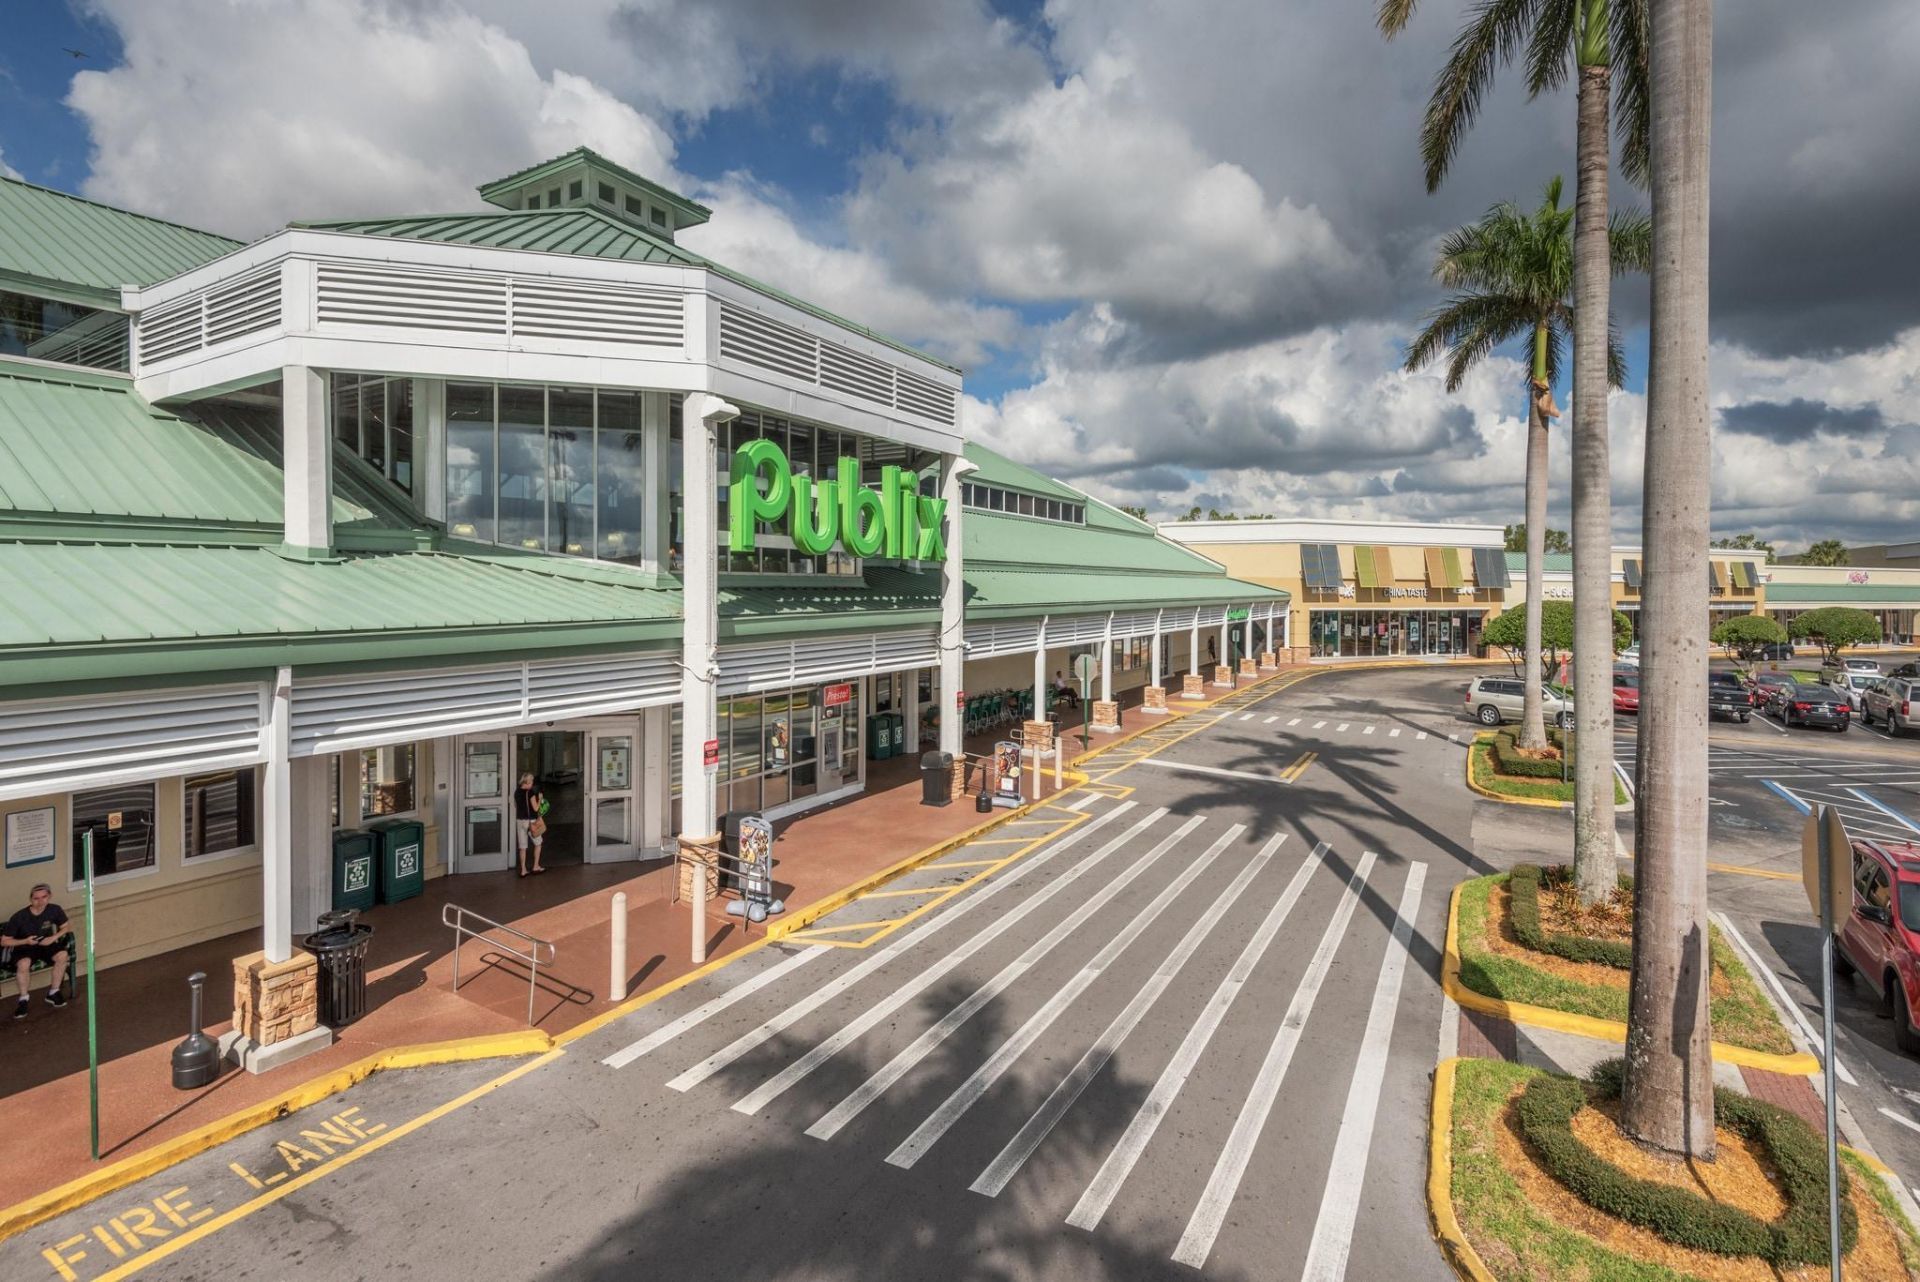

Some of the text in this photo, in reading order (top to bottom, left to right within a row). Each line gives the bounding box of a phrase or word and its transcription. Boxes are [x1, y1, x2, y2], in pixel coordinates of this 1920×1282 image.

[729, 438, 948, 562] Publix
[1383, 587, 1429, 598] CHINA TASTE
[42, 1106, 388, 1282] FIRE LANE
